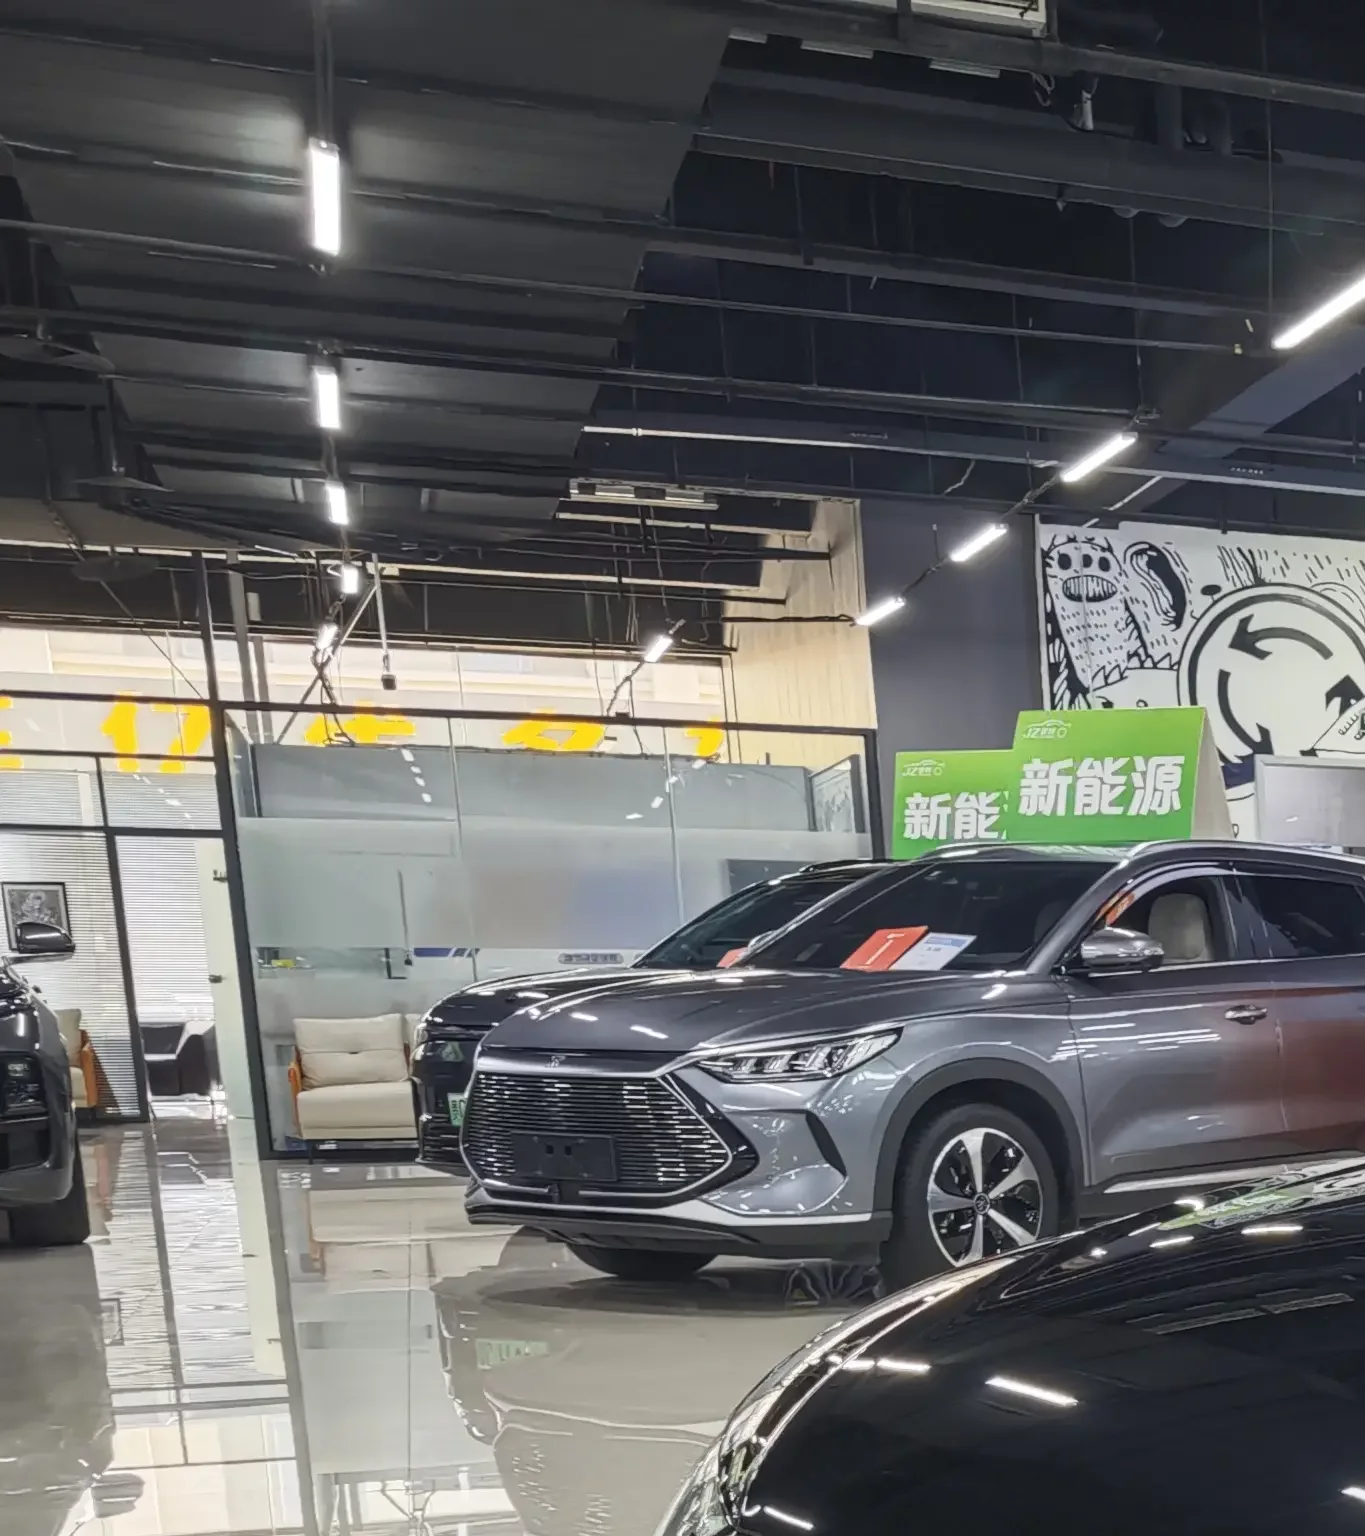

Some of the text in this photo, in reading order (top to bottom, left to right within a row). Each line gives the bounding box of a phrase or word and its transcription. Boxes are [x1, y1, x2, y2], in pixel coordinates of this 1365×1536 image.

[1018, 755, 1185, 816] 新能源
[902, 790, 1009, 841] 新能
